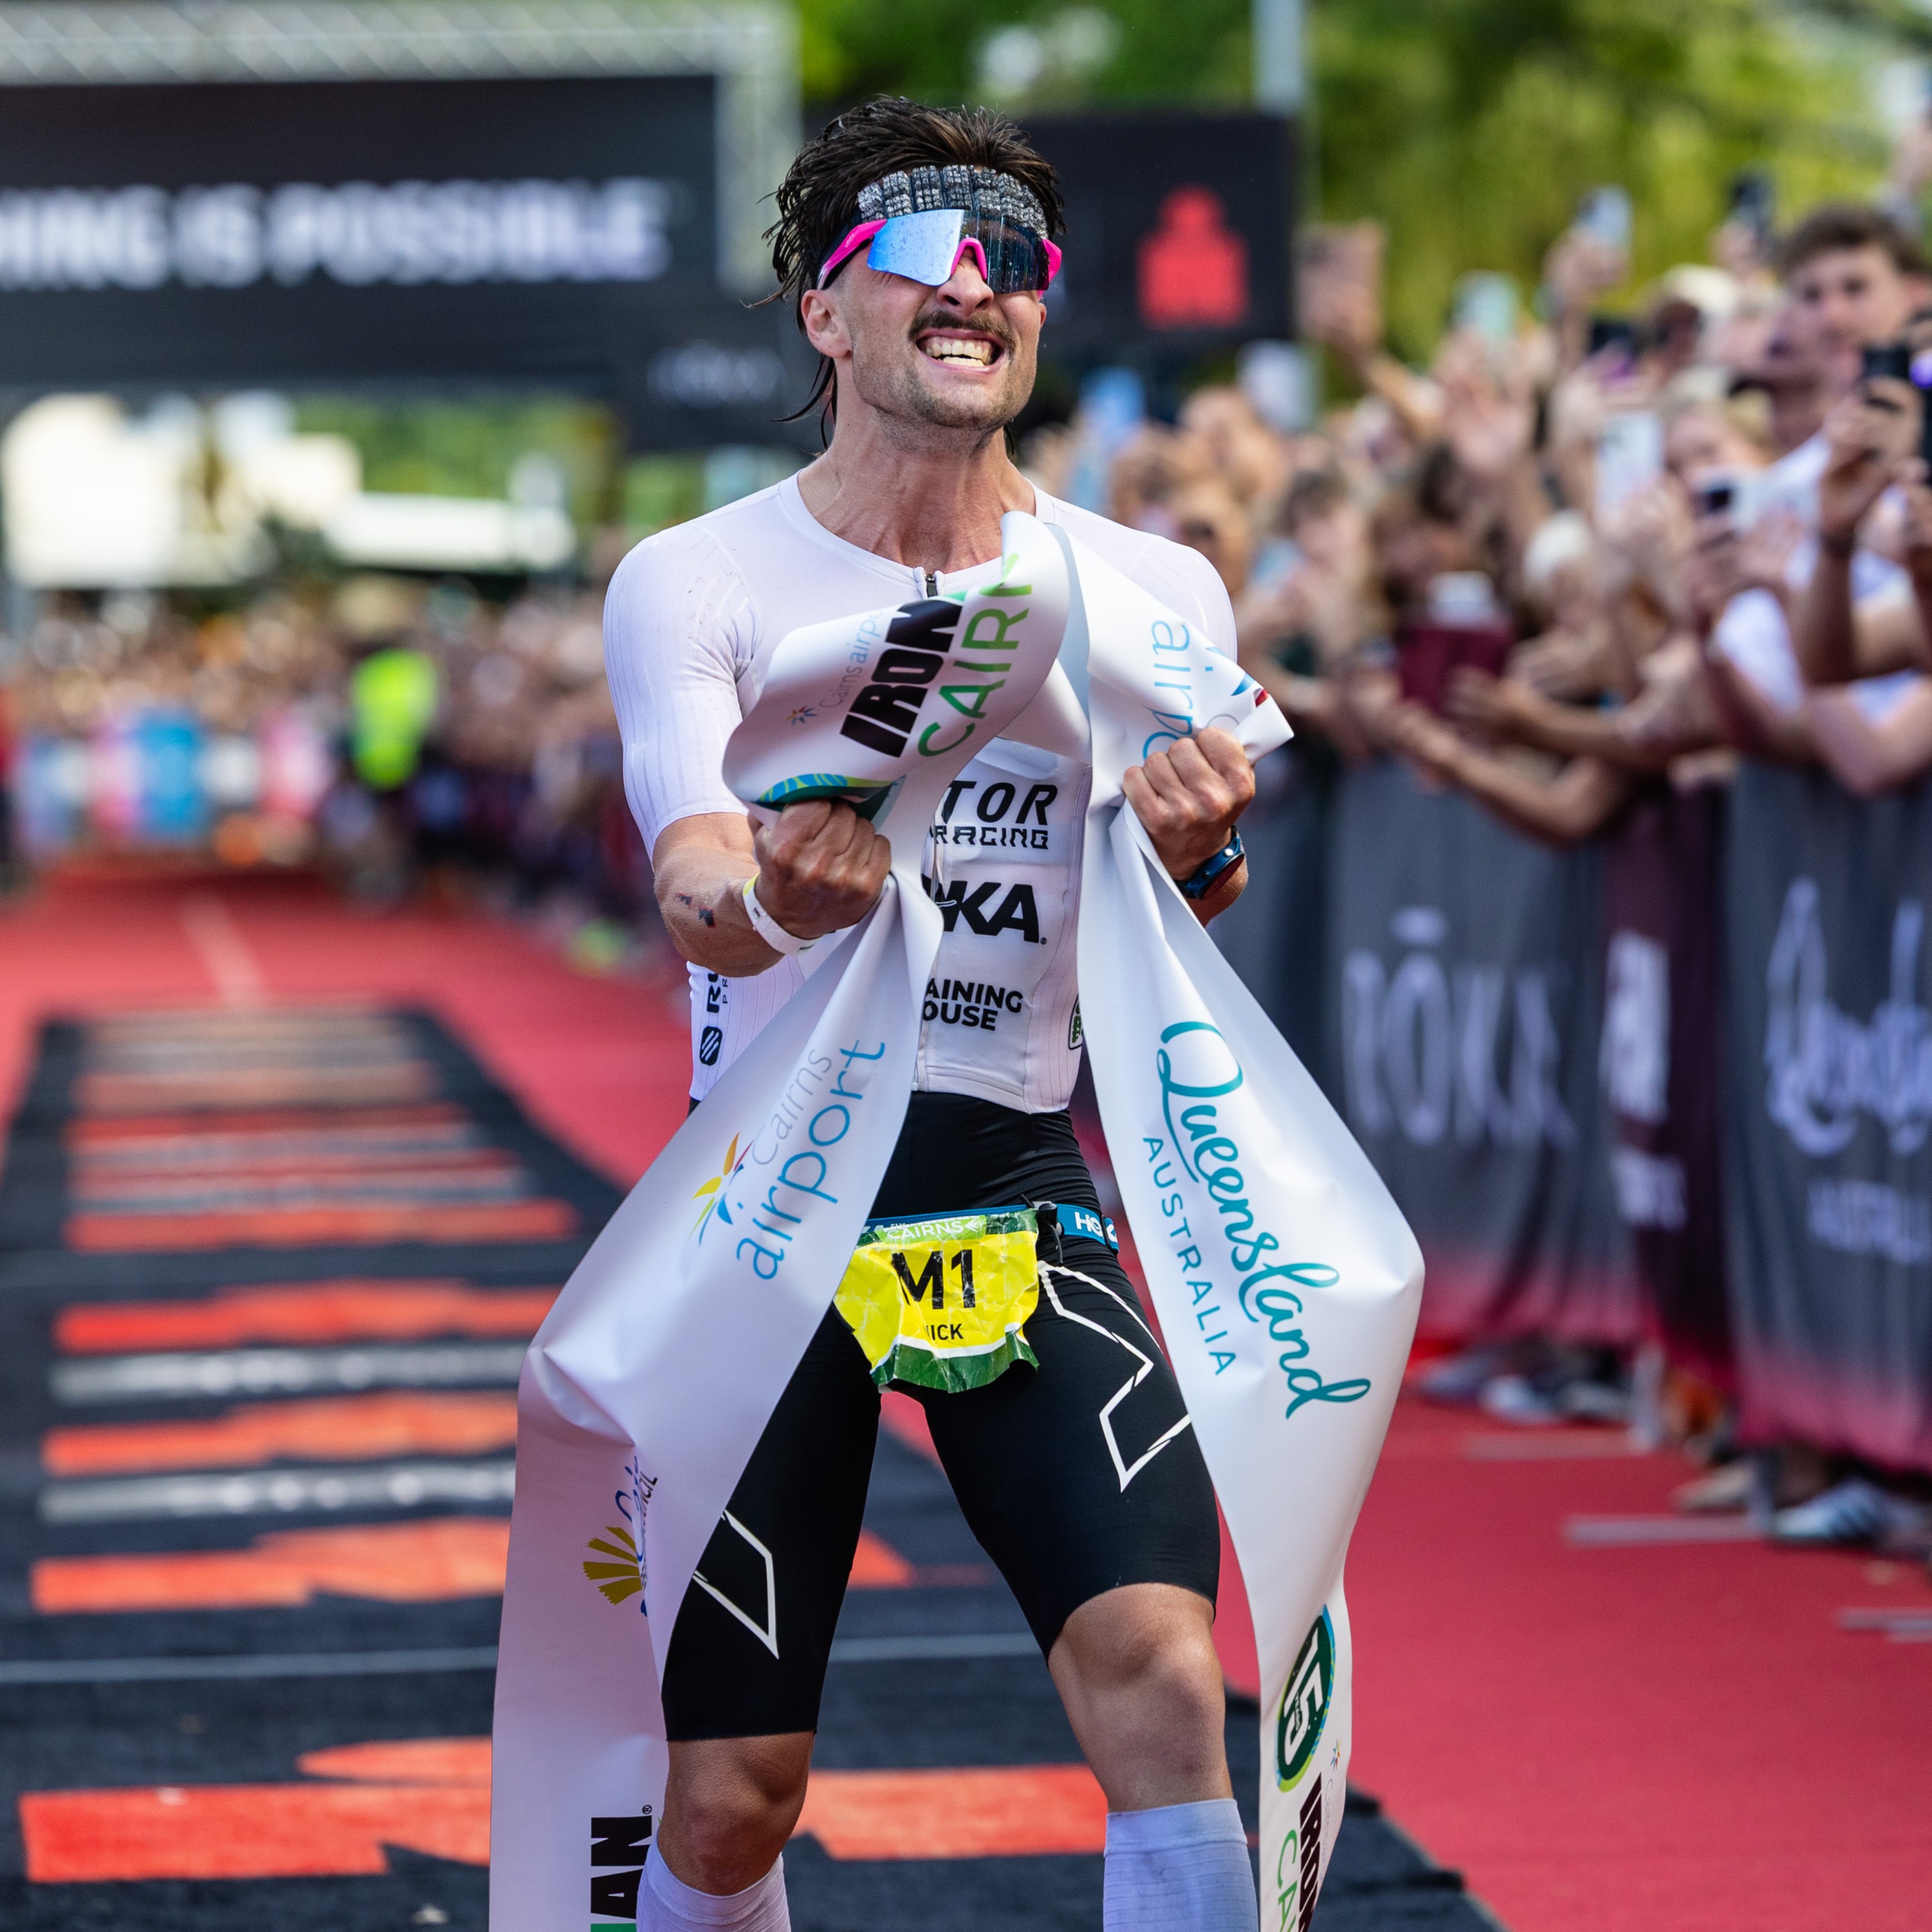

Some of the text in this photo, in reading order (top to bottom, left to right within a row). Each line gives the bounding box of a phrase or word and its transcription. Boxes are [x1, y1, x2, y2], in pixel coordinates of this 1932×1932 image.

[736, 1039, 886, 1280] airport
[752, 1048, 833, 1166] Cairns
[887, 1221, 964, 1240] CAIRNS
[891, 1249, 976, 1310] M1
[1142, 1137, 1237, 1377] AUSTRALIA
[1157, 1021, 1371, 1419] Queensland
